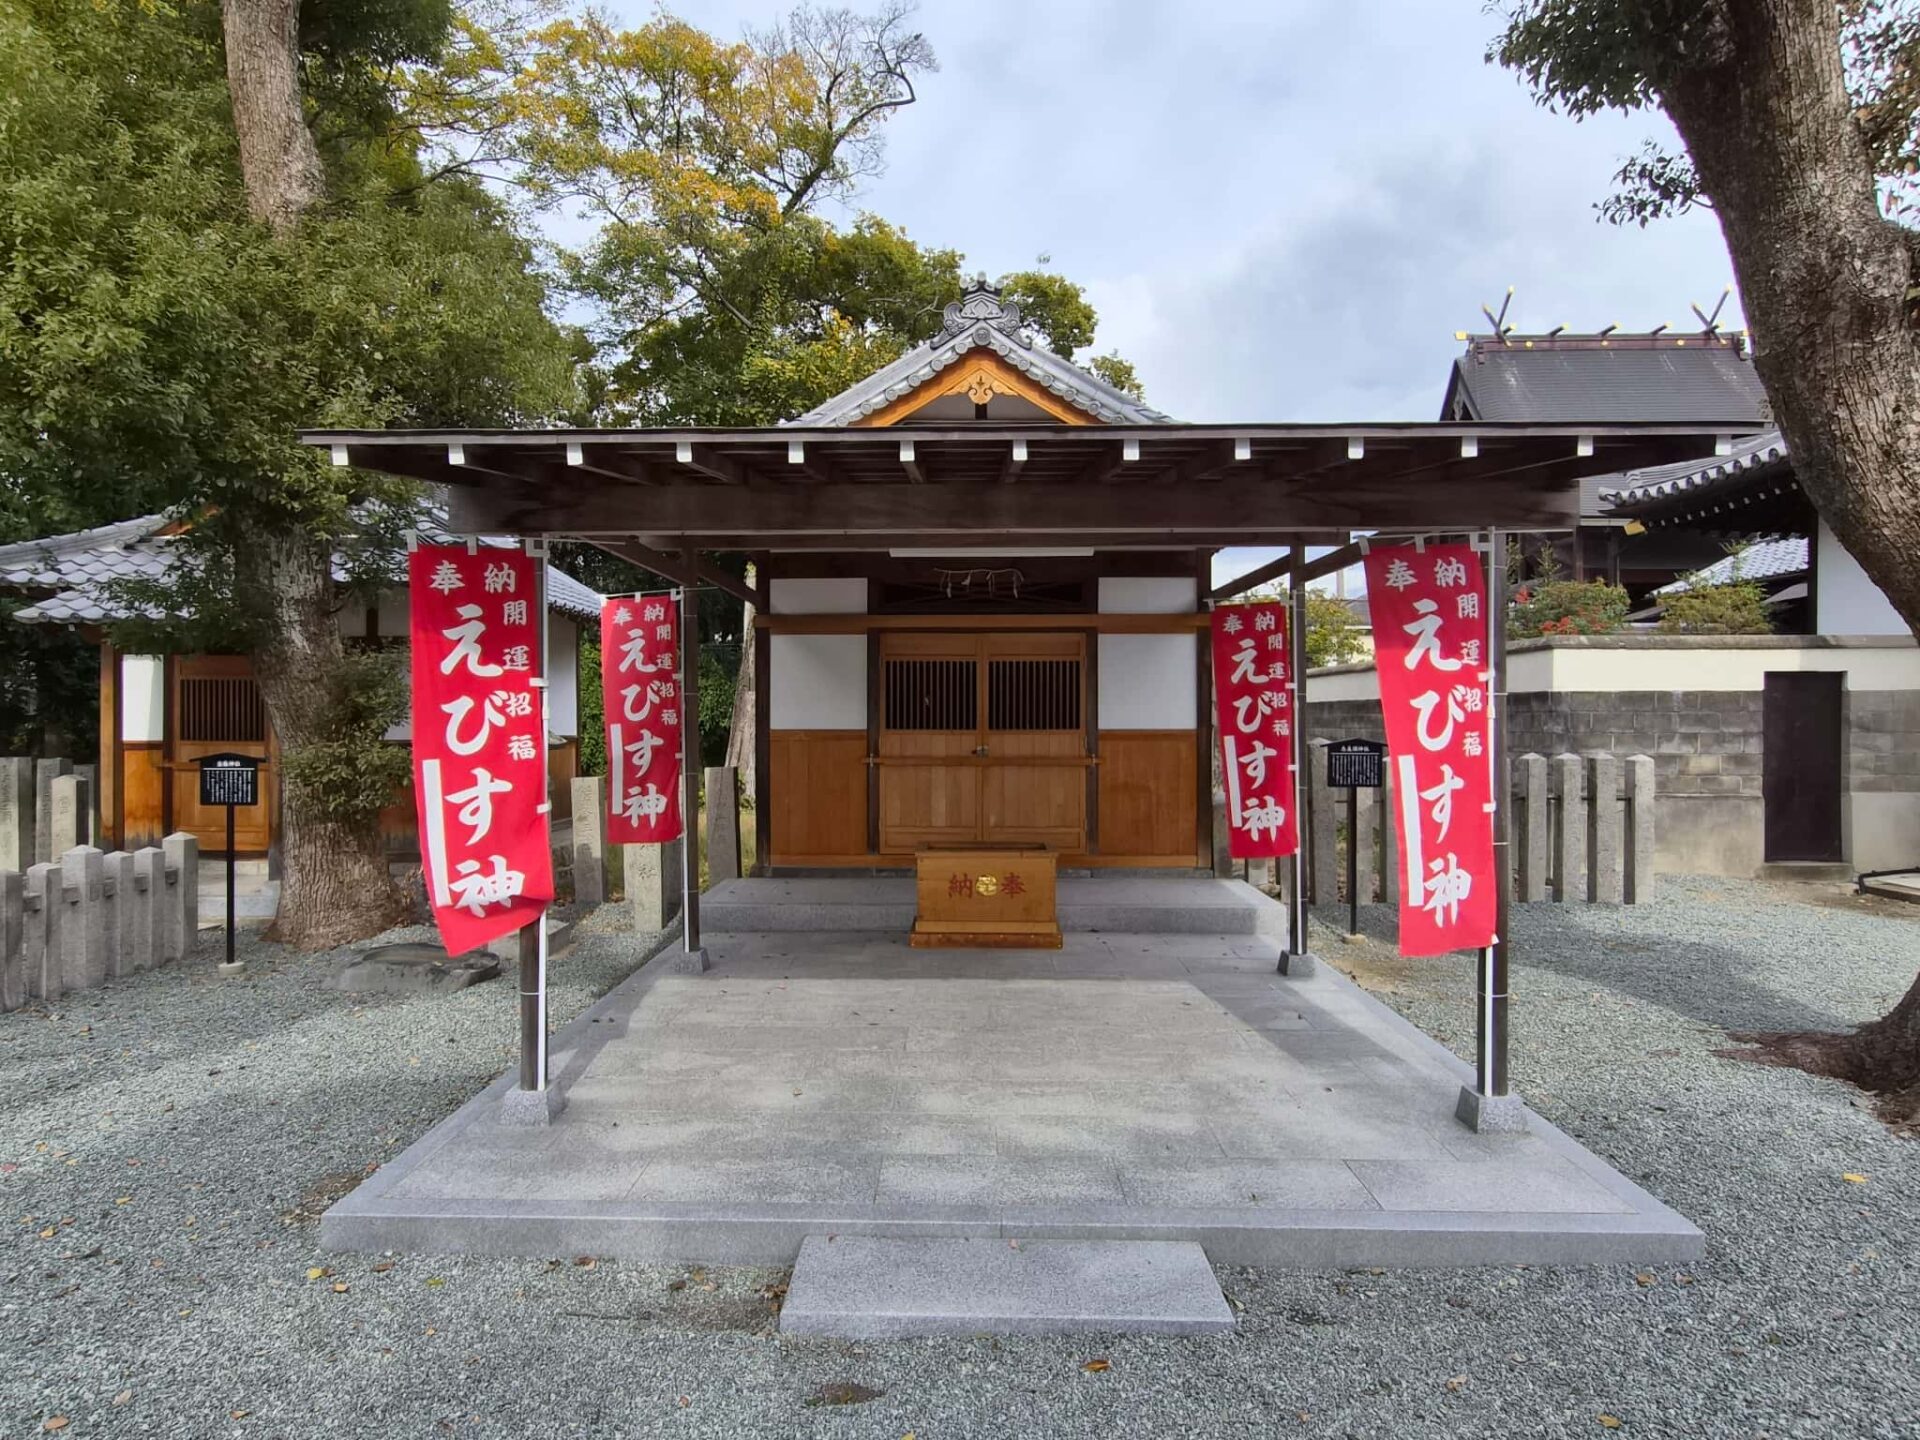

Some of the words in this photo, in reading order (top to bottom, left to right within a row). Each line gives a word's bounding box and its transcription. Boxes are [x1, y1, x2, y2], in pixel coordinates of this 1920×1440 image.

[440, 603, 525, 918] えびす神
[502, 600, 536, 761] 開運招福
[619, 628, 668, 829] えびす神
[656, 624, 678, 726] 開運招福
[1231, 638, 1285, 843] えびす神
[1267, 633, 1289, 736] 開運招福
[1402, 598, 1472, 928] えびす神
[1456, 592, 1481, 757] 開運招福
